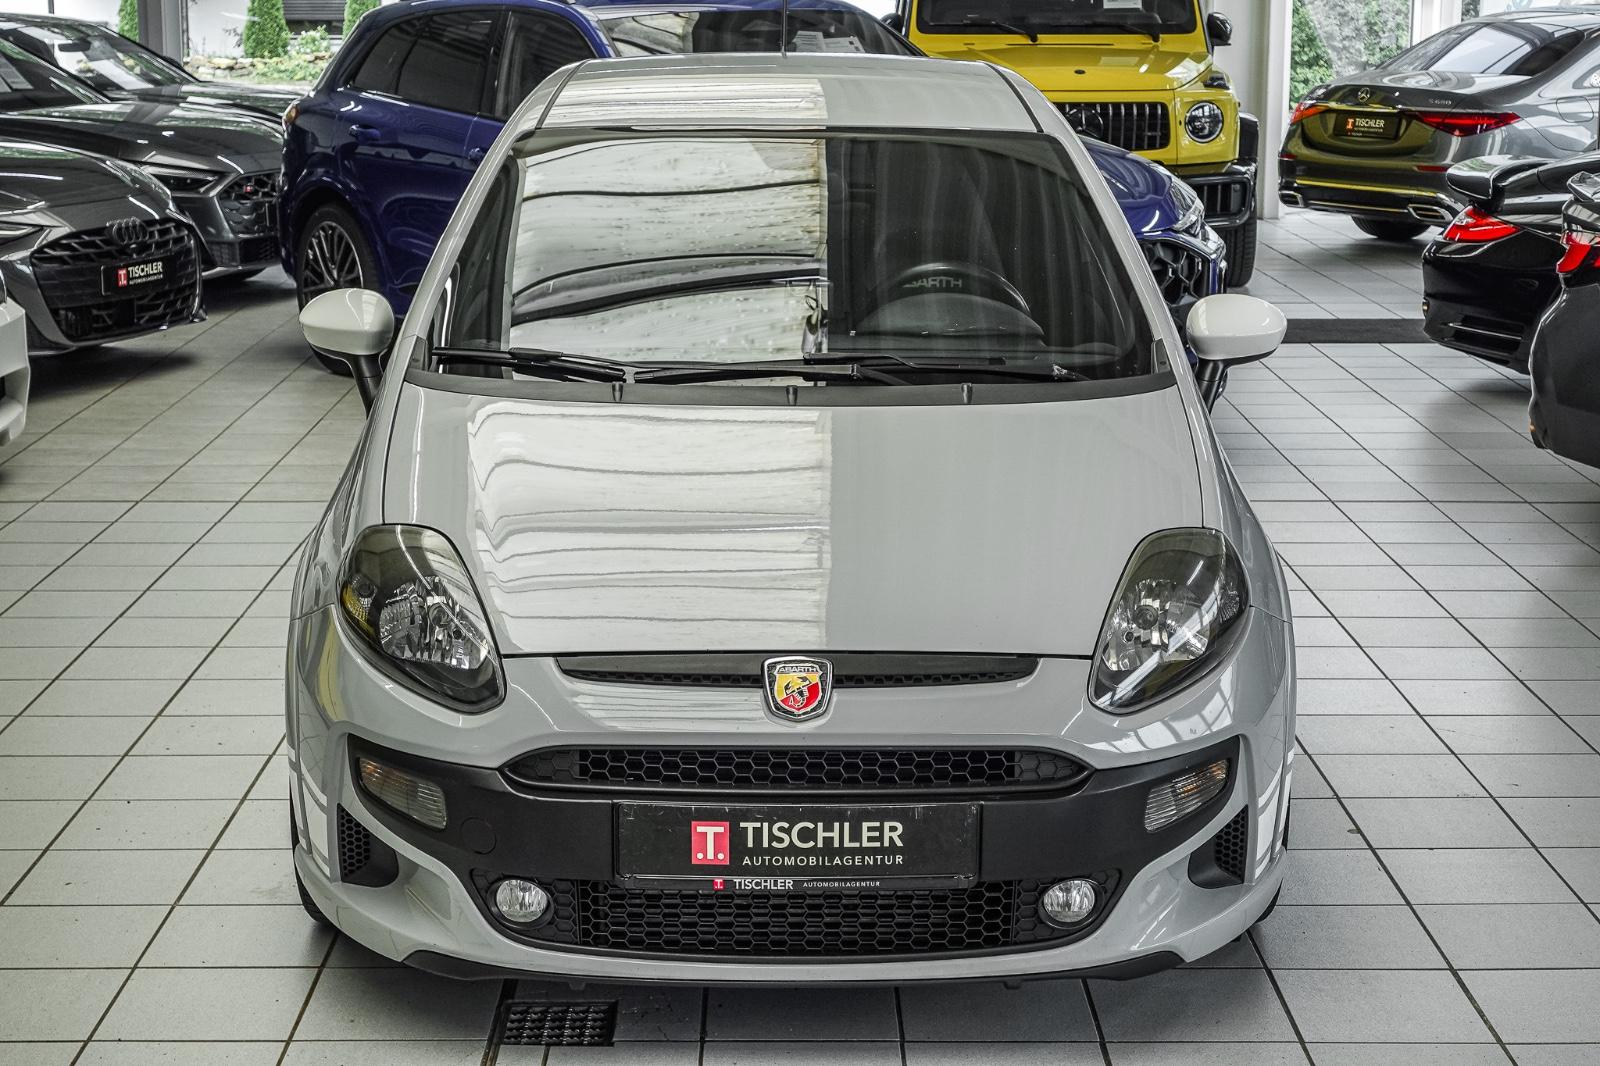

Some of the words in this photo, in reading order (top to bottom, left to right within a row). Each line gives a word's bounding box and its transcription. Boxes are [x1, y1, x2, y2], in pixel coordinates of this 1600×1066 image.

[1355, 118, 1385, 128] TISCHLER
[128, 261, 163, 278] TISCHLER
[739, 821, 904, 849] TISCHLER
[742, 855, 904, 866] AUTOMOBILAGENTUR
[733, 879, 794, 890] TISCHLER
